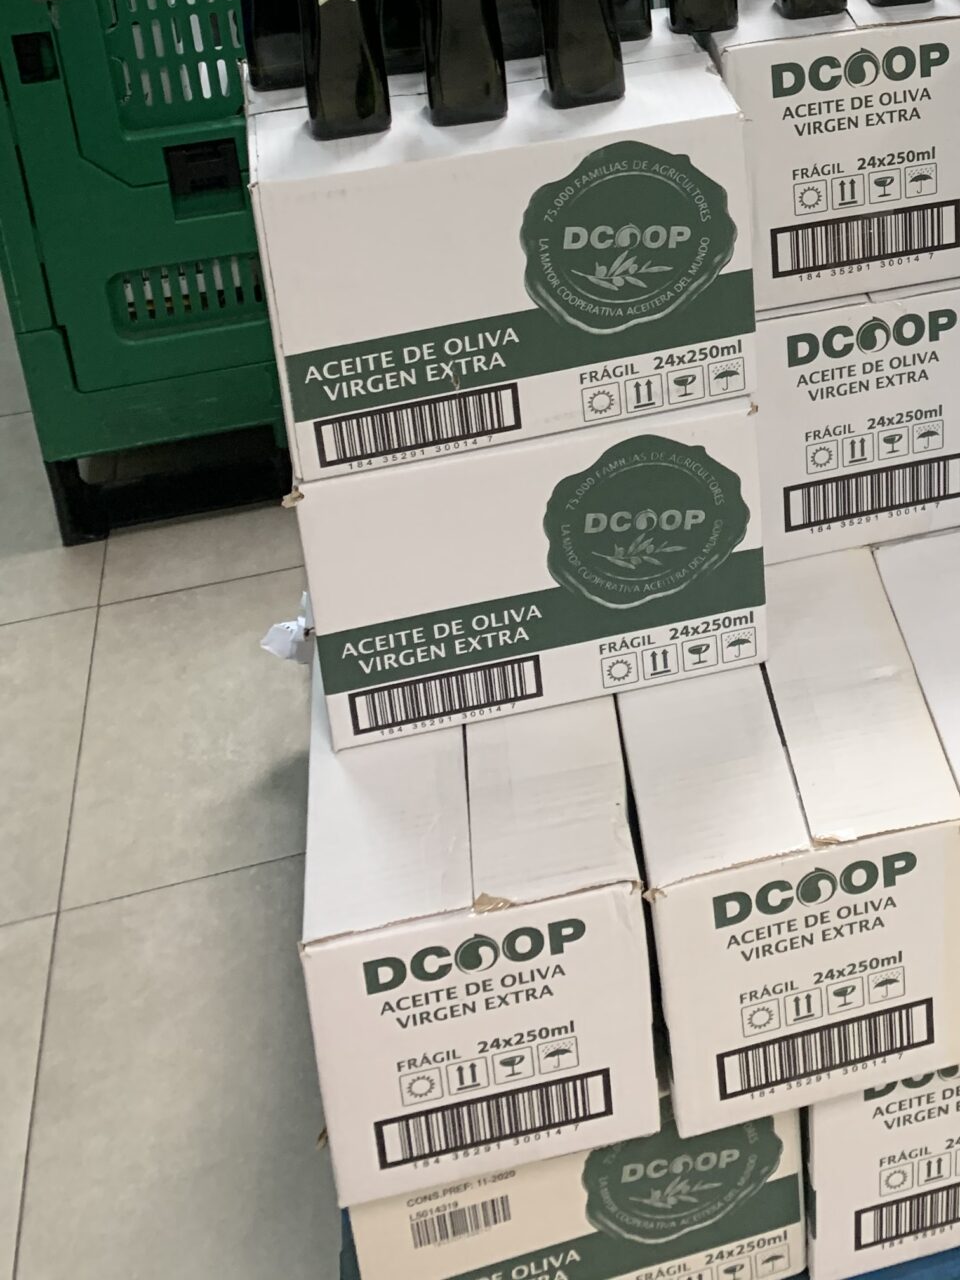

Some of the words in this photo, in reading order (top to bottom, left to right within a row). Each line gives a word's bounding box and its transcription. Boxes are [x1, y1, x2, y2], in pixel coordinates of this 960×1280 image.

[771, 43, 949, 98] DCOOP
[782, 99, 845, 120] ACEITE
[851, 95, 873, 110] DE
[879, 88, 931, 105] OLIVA
[794, 116, 859, 136] VIRGEN
[865, 108, 921, 127] EXTRA
[792, 163, 844, 180] FRÁGIL
[857, 147, 936, 170] 24x250ml
[544, 186, 574, 222] 75.000
[574, 160, 628, 188] FAMILIAS
[633, 160, 648, 170] DE
[652, 163, 711, 222] AGRICULTORES
[539, 239, 549, 253] LA
[563, 222, 691, 250] DCOOP
[540, 255, 559, 288] MAYOR
[688, 237, 710, 277] MUNDO
[557, 287, 624, 316] COOPERATIVA
[627, 291, 675, 315] ACEITERA
[674, 276, 691, 292] DEL
[305, 352, 395, 383] ACEITE
[403, 342, 435, 363] DE
[444, 328, 519, 356] OLIVA
[787, 309, 957, 368] DCOOP
[324, 369, 417, 401] VIRGEN
[427, 352, 506, 381] EXTRA
[579, 363, 639, 385] FRÁGIL
[653, 339, 743, 371] 24x250ml
[797, 365, 856, 387] ACEITE
[862, 360, 884, 375] DE
[890, 351, 939, 369] OLIVA
[808, 380, 870, 401] VIRGEN
[876, 370, 929, 389] EXTRA
[805, 424, 855, 441] FRÁGIL
[867, 405, 942, 430] 24x250ml
[349, 458, 373, 470] 184
[382, 448, 426, 463] 35291
[435, 438, 478, 452] 30014
[584, 509, 705, 533] DCOOP
[342, 629, 426, 659] ACEITE
[434, 621, 462, 640] DE
[472, 604, 542, 633] OLIVA
[358, 646, 445, 674] VIRGEN
[455, 629, 529, 656] EXTRA
[599, 635, 655, 654] FRÁGIL
[669, 611, 754, 641] 24x250ml
[712, 851, 917, 929] DCOOP
[727, 919, 798, 949] ACEITE
[804, 912, 830, 928] DE
[837, 896, 897, 920] OLIVA
[741, 934, 814, 962] VIRGEN
[822, 916, 885, 942] EXTRA
[363, 918, 586, 995] DCOOP
[380, 986, 457, 1015] ACEITE
[465, 979, 494, 996] DE
[500, 964, 566, 988] OLIVA
[739, 980, 799, 1004] FRÁGIL
[814, 951, 903, 985] 24x250ml
[396, 1001, 477, 1029] VIRGEN
[484, 985, 554, 1011] EXTRA
[396, 1049, 462, 1072] FRÁGIL
[477, 1020, 575, 1054] 24x250ml
[872, 1094, 935, 1119] ACEITE
[884, 1105, 949, 1130] VIRGEN
[880, 1146, 932, 1167] FRÁGIL
